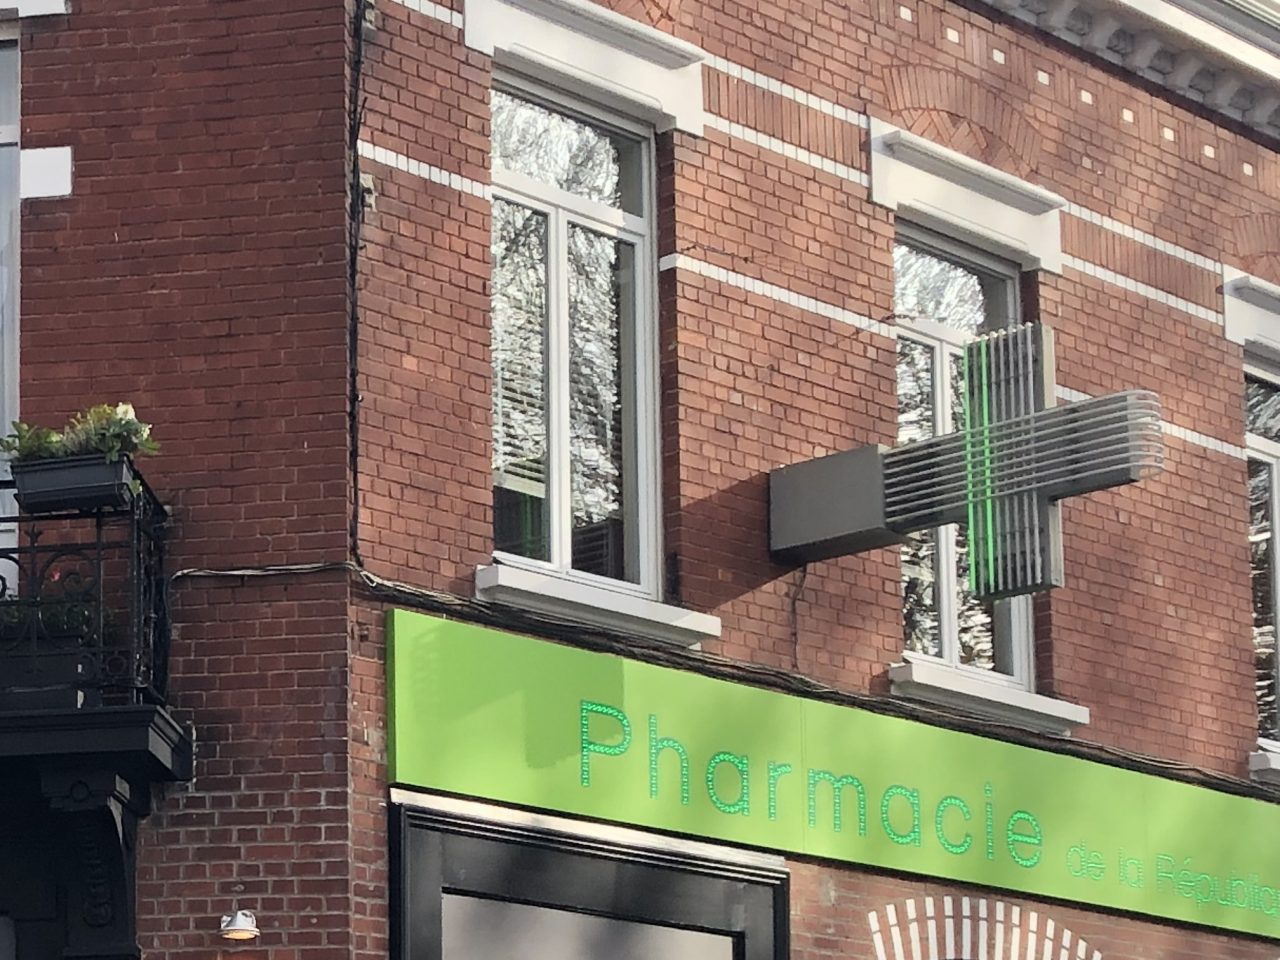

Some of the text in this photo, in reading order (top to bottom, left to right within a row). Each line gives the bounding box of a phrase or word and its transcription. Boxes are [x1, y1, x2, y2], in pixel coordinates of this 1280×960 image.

[579, 699, 1280, 919] Pharmacie de la Républiq
